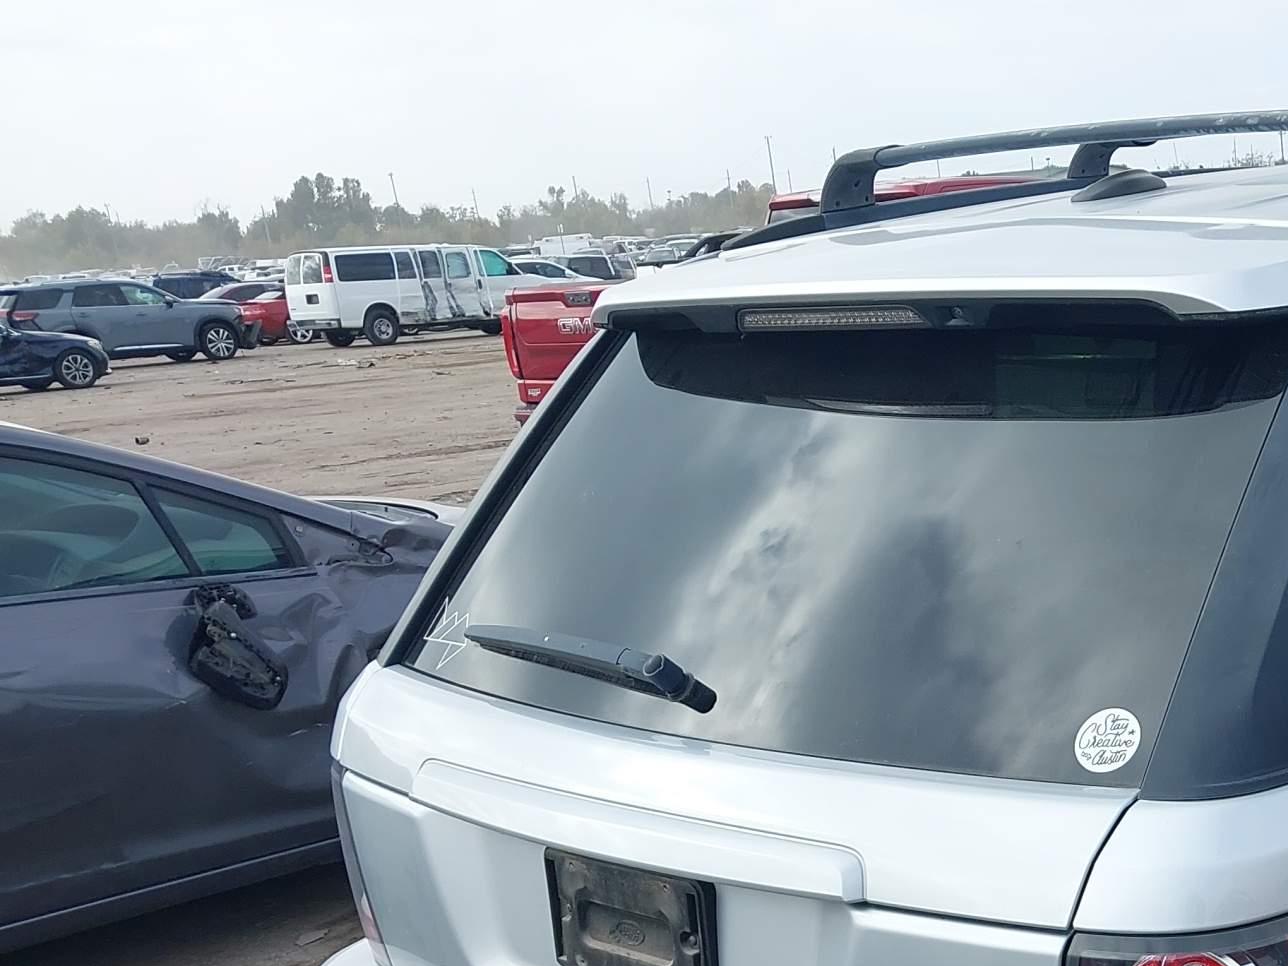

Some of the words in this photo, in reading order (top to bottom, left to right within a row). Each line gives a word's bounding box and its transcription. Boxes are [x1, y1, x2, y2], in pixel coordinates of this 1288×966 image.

[557, 317, 600, 335] GM
[1079, 722, 1135, 749] Creative
[1096, 713, 1130, 737] Stay
[1091, 749, 1128, 766] Austin
